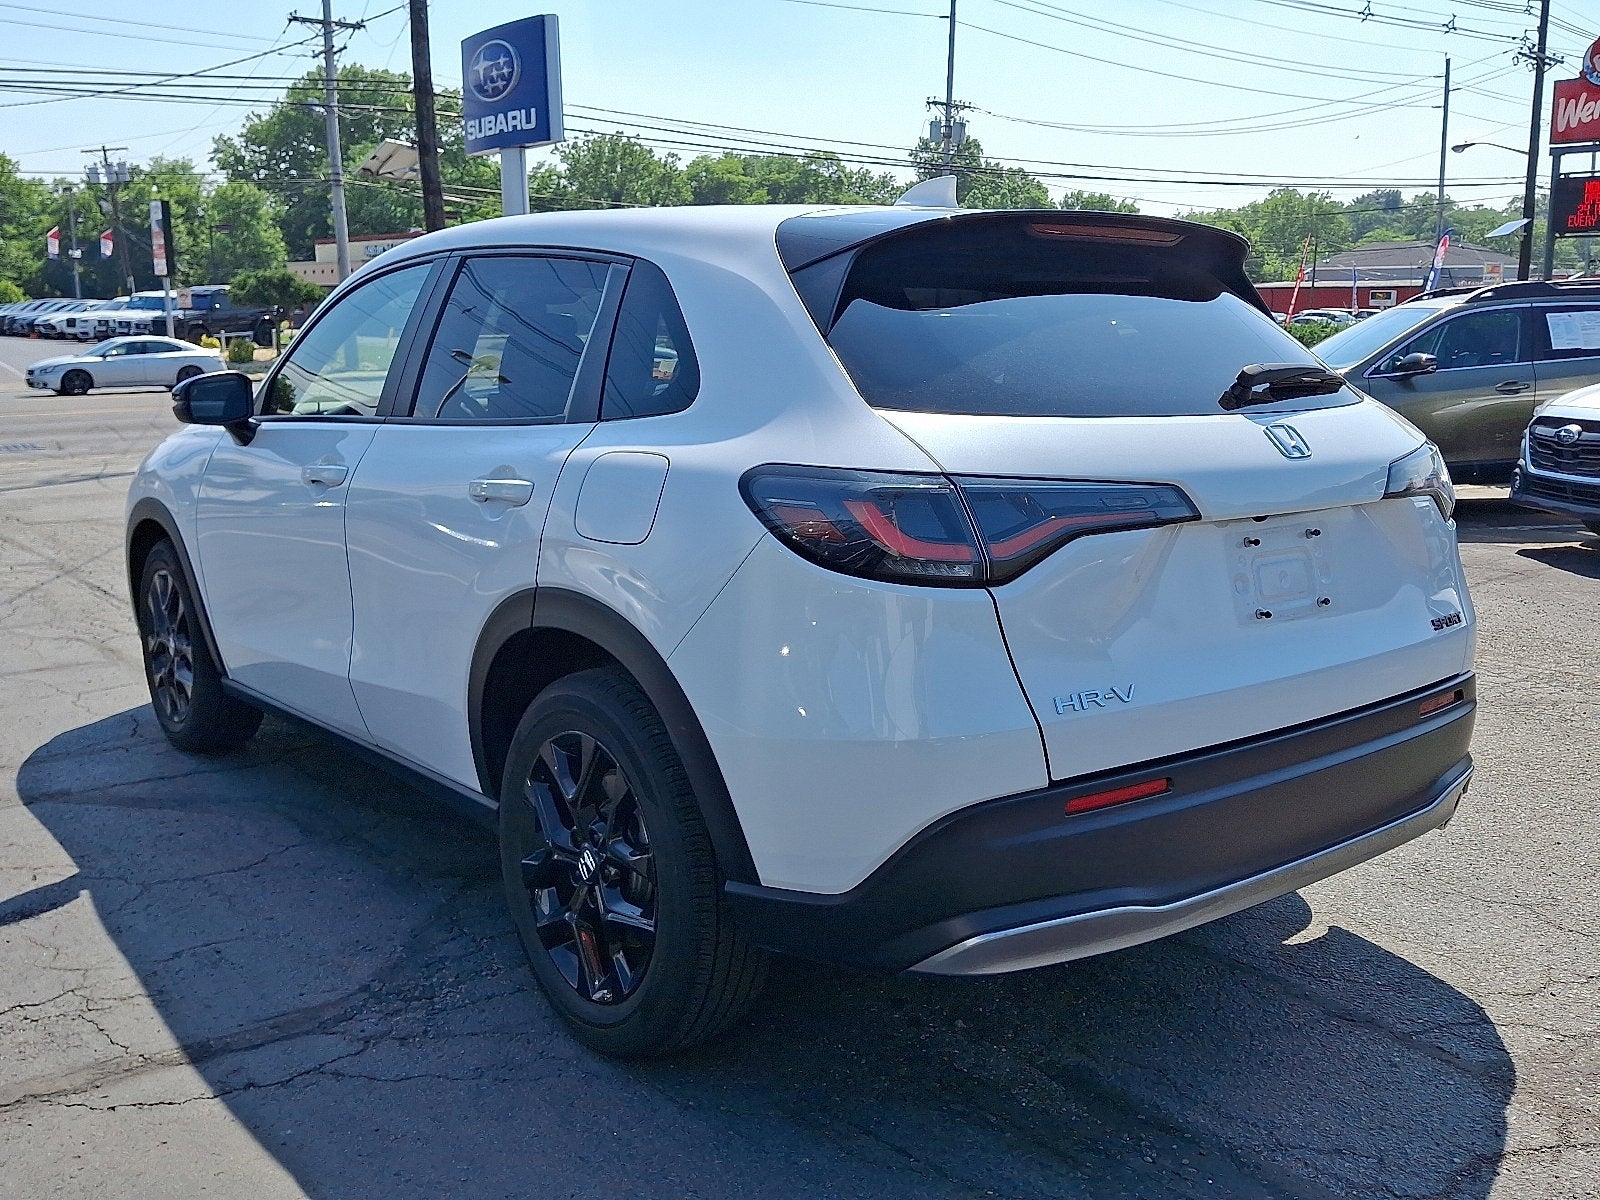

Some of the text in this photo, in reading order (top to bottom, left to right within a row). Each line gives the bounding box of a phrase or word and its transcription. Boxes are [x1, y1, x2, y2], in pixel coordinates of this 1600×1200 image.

[466, 107, 537, 141] SUBARU
[1577, 204, 1590, 216] 24
[1567, 214, 1597, 227] EVERY
[1430, 611, 1462, 631] SPORT
[1053, 683, 1135, 715] HR-V
